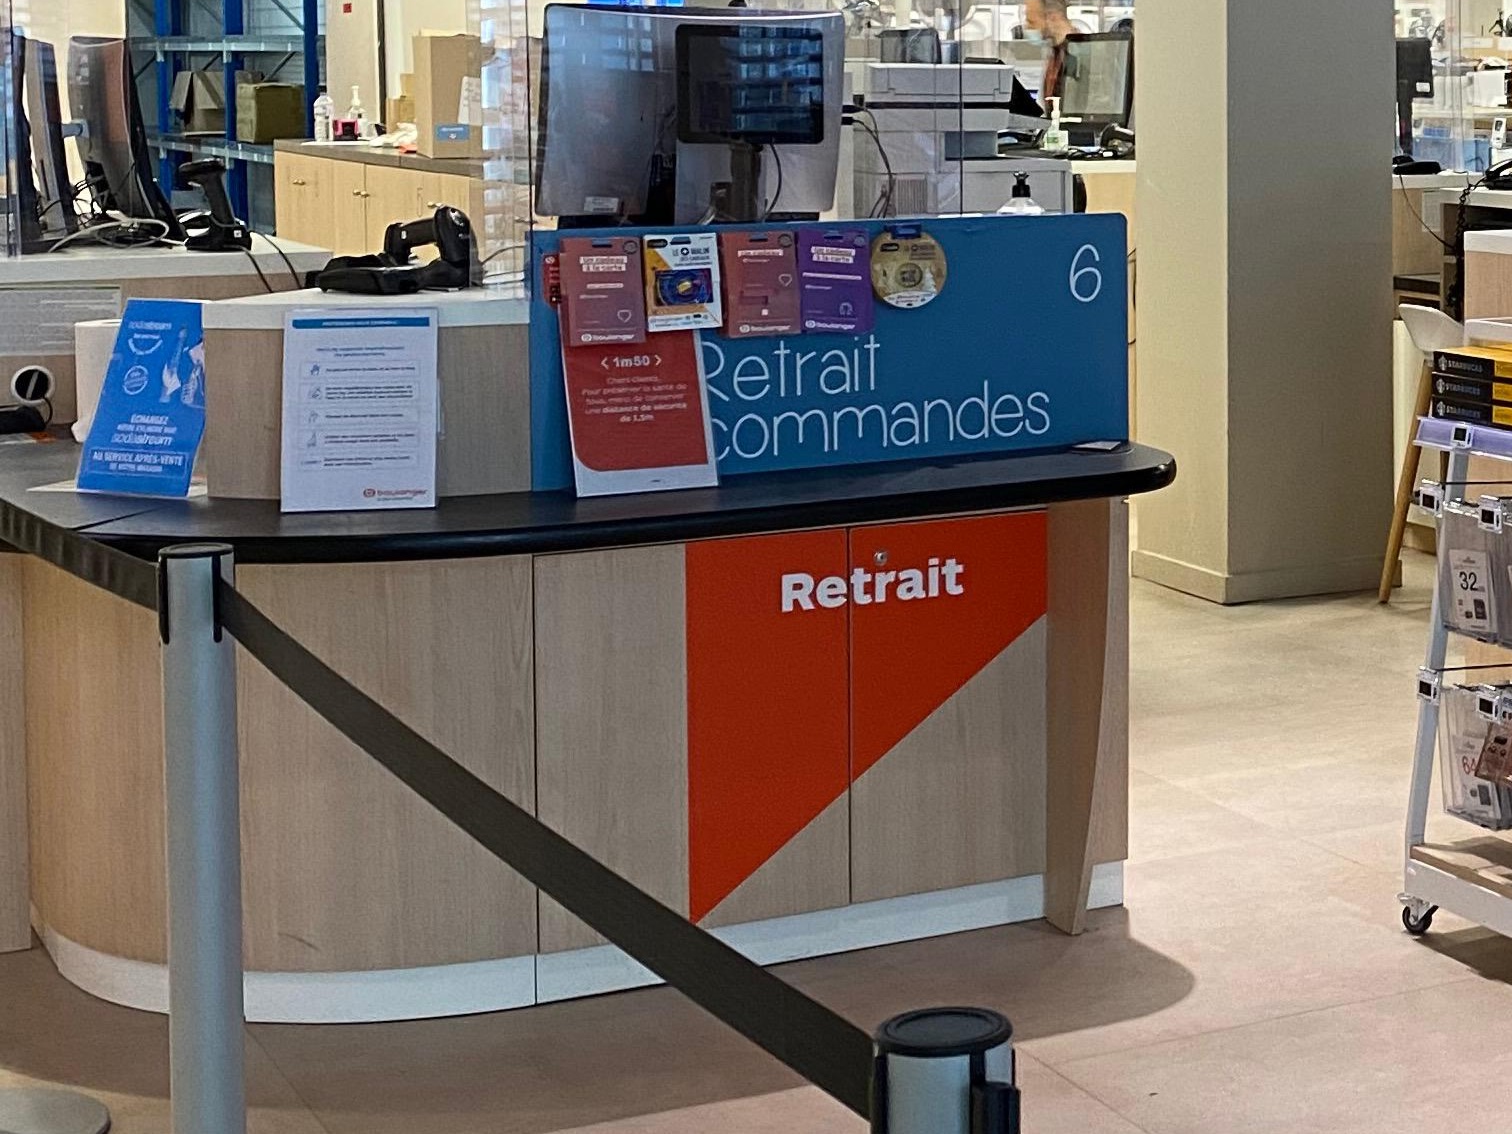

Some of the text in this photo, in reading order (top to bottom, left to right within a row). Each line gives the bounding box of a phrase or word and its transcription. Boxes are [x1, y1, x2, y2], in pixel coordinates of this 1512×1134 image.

[1069, 243, 1102, 303] 6
[592, 333, 635, 342] boulanger
[613, 355, 651, 368] 1m50
[701, 333, 880, 403] Retrait
[1447, 359, 1483, 373] STARBUCKS
[602, 405, 639, 414] distance
[639, 404, 652, 412] de
[711, 380, 1051, 460] commandes
[104, 451, 133, 463] SERVICE
[377, 488, 427, 498] boulanger
[780, 556, 965, 613] Retrait
[1458, 571, 1478, 592] 32
